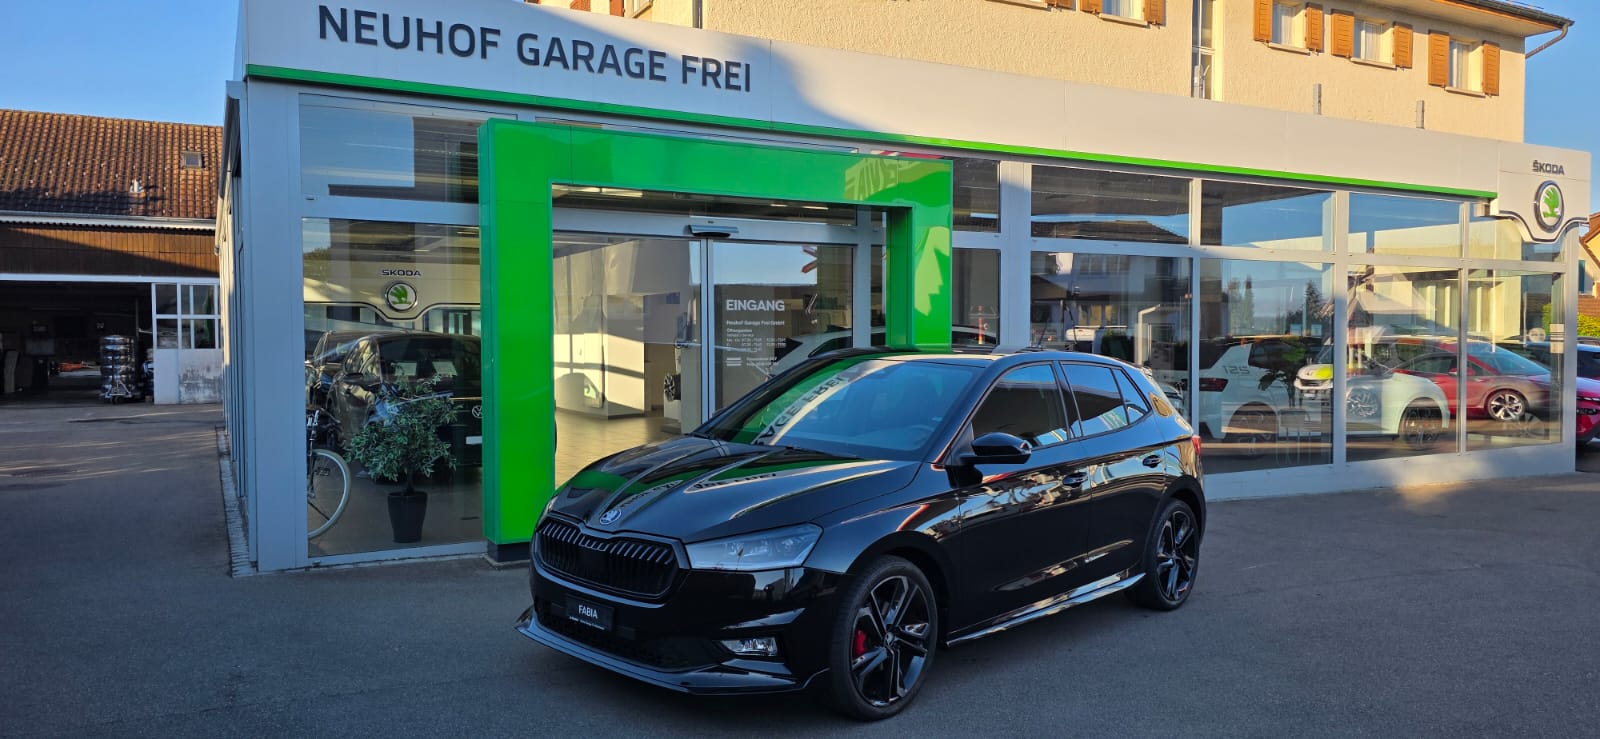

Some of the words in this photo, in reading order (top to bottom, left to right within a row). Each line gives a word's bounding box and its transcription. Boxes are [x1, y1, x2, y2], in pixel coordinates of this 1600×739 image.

[318, 4, 501, 60] NEUHOF
[516, 32, 667, 83] GARAGE
[681, 55, 752, 93] FREI
[1532, 160, 1565, 175] ŠKODA
[726, 299, 785, 312] EINGANG
[578, 604, 598, 620] FABIA
